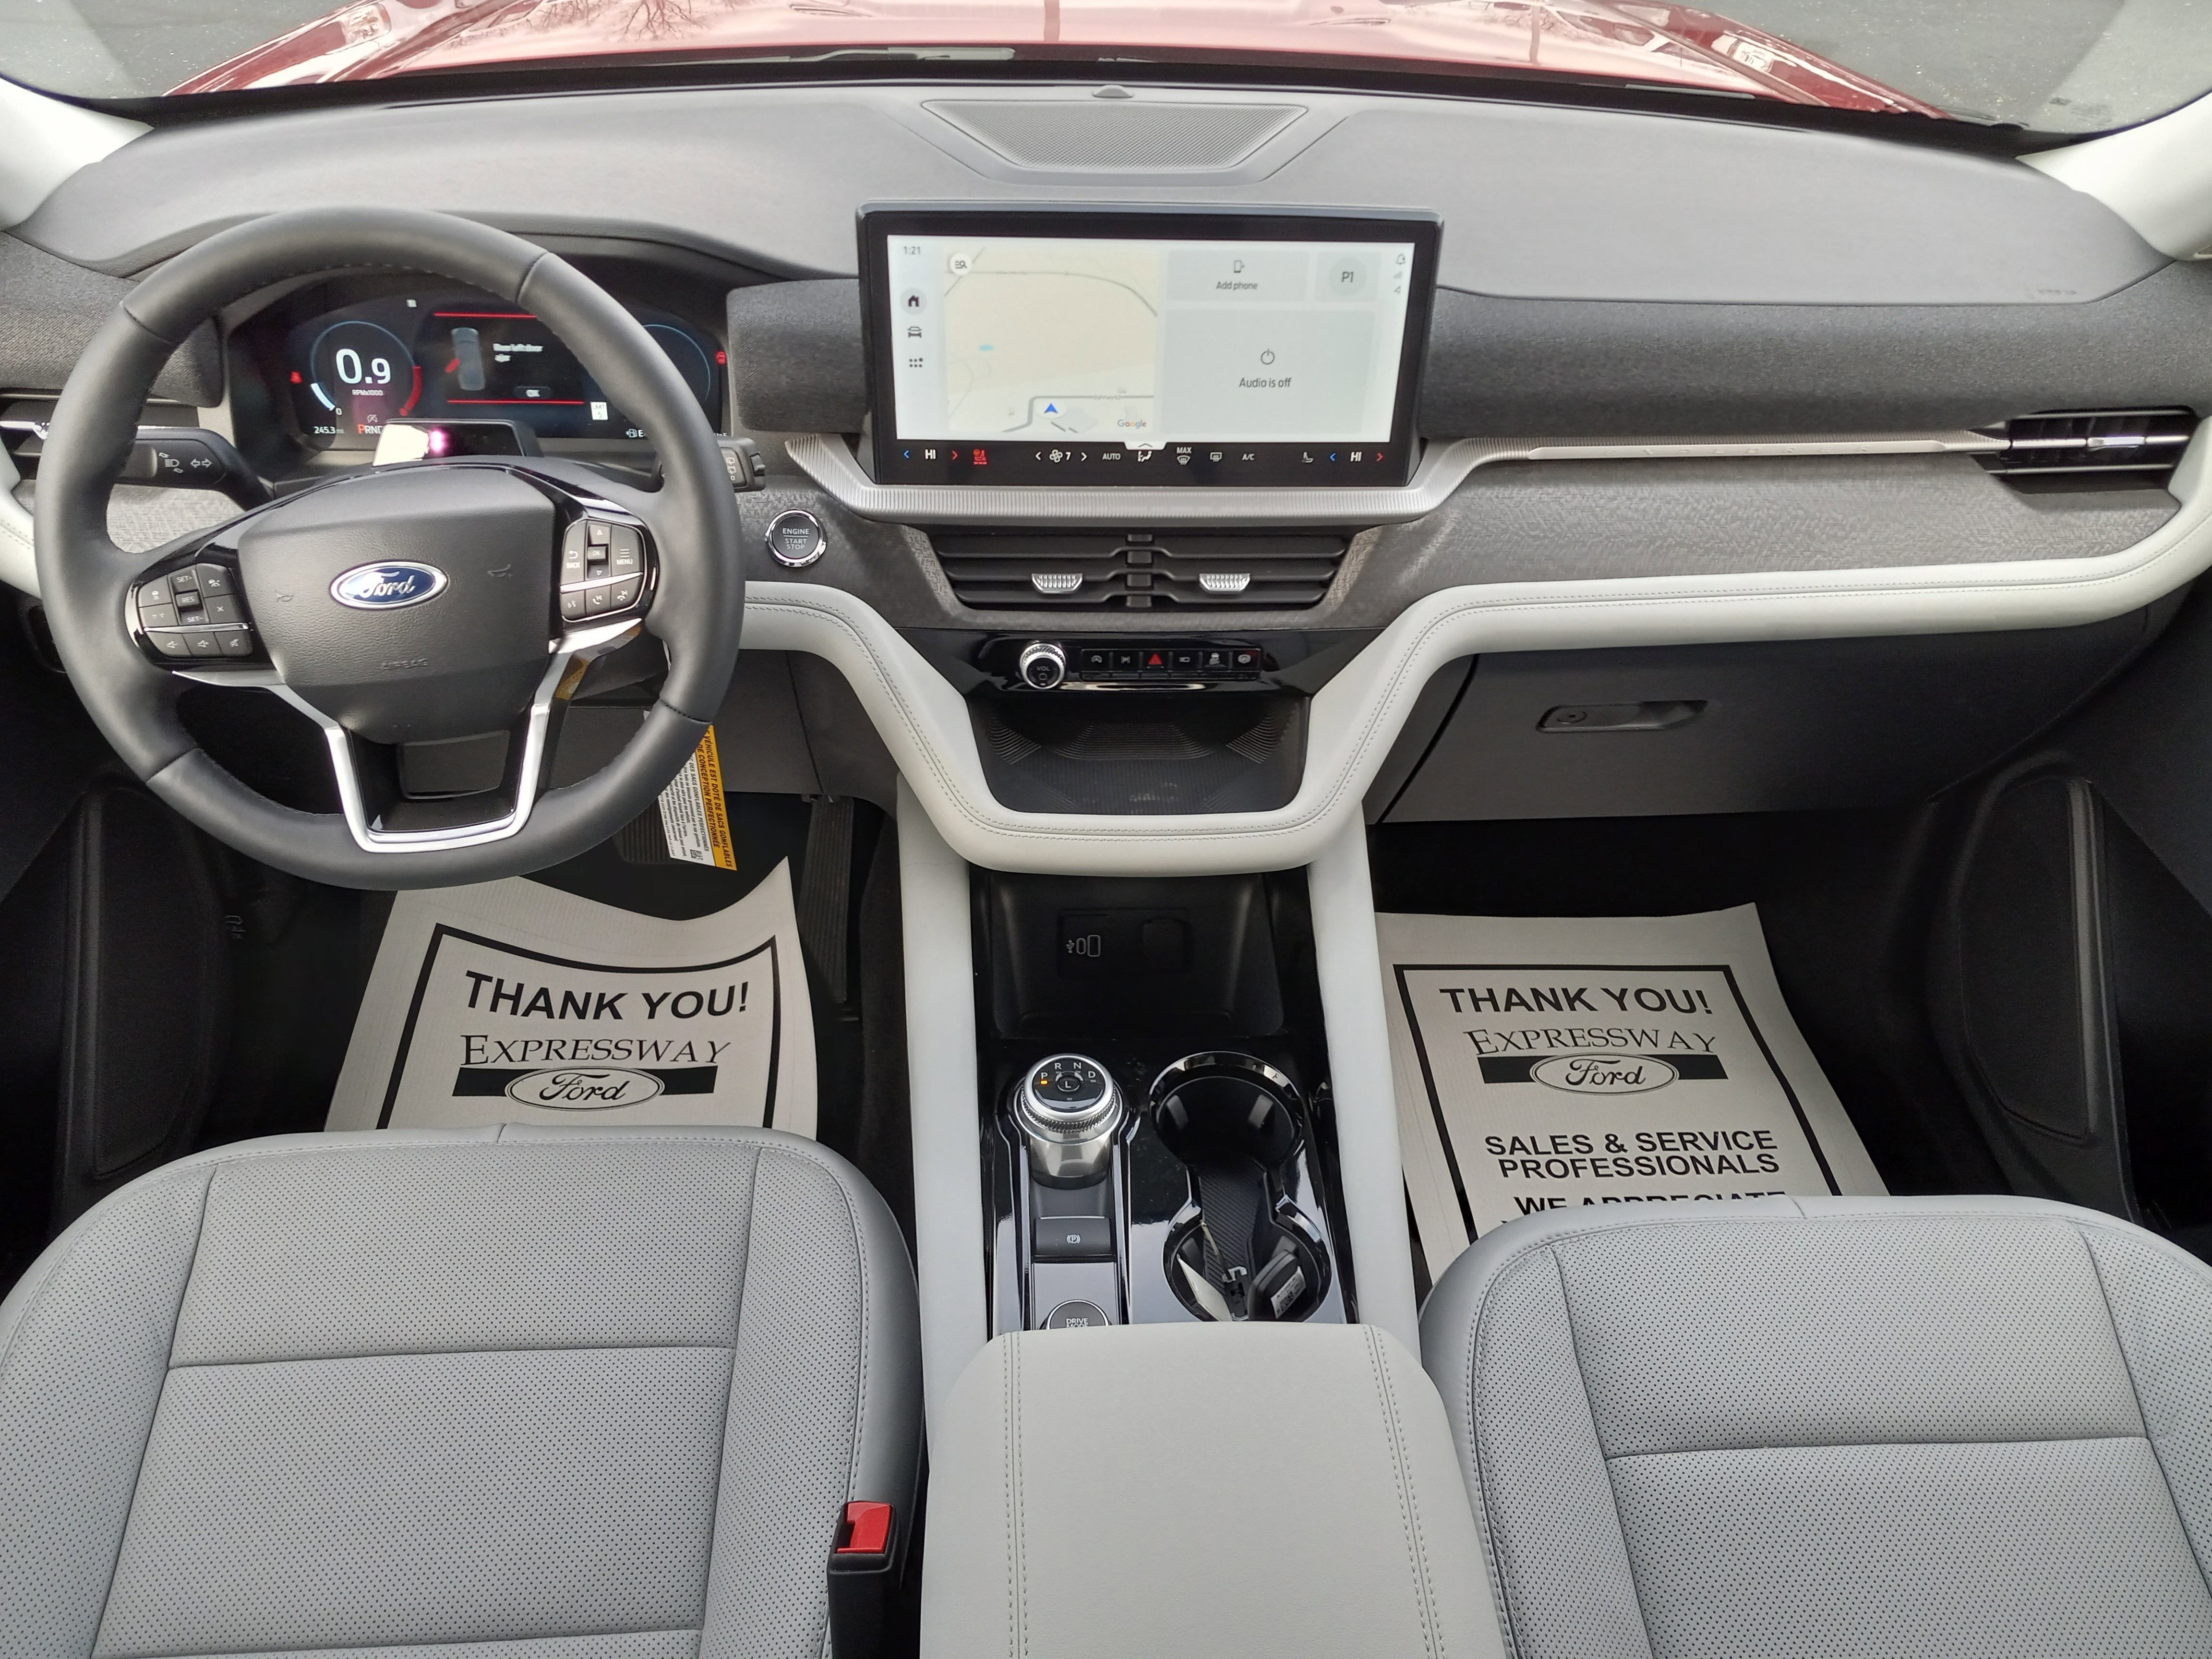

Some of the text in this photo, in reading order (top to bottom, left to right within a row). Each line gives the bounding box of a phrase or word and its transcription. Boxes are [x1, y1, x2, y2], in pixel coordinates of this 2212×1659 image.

[904, 246, 920, 255] 1:21
[1216, 281, 1258, 290] Add phone
[1342, 272, 1354, 282] P1
[336, 349, 391, 384] 0.9
[1239, 377, 1292, 388] Audio is off
[1118, 419, 1147, 429] Google
[926, 449, 936, 460] HI
[1065, 452, 1071, 461] 7
[1102, 453, 1121, 461] AUTO
[1350, 451, 1362, 462] HI
[361, 571, 416, 599] Ford
[702, 735, 715, 768] VÉHICULE
[693, 787, 702, 816] GONFLABLES
[697, 744, 720, 848] DE CONCEPTION PERFECTIONNÉE
[711, 783, 721, 801] DOTÉ
[715, 803, 721, 811] DE
[716, 813, 724, 828] SACS
[720, 830, 732, 866] GONFLABLES
[465, 970, 749, 1020] THANK YOU!
[1440, 987, 1713, 1014] THANK YOU!
[460, 1034, 731, 1065] EXPRESSWAY
[1463, 1028, 1716, 1055] EXPRESSWAY
[1565, 1058, 1646, 1086] Ford
[540, 1072, 631, 1101] Ford
[1485, 1130, 1778, 1155] SALES & SERVICE
[1498, 1153, 1780, 1179] PROFESSIONALS
